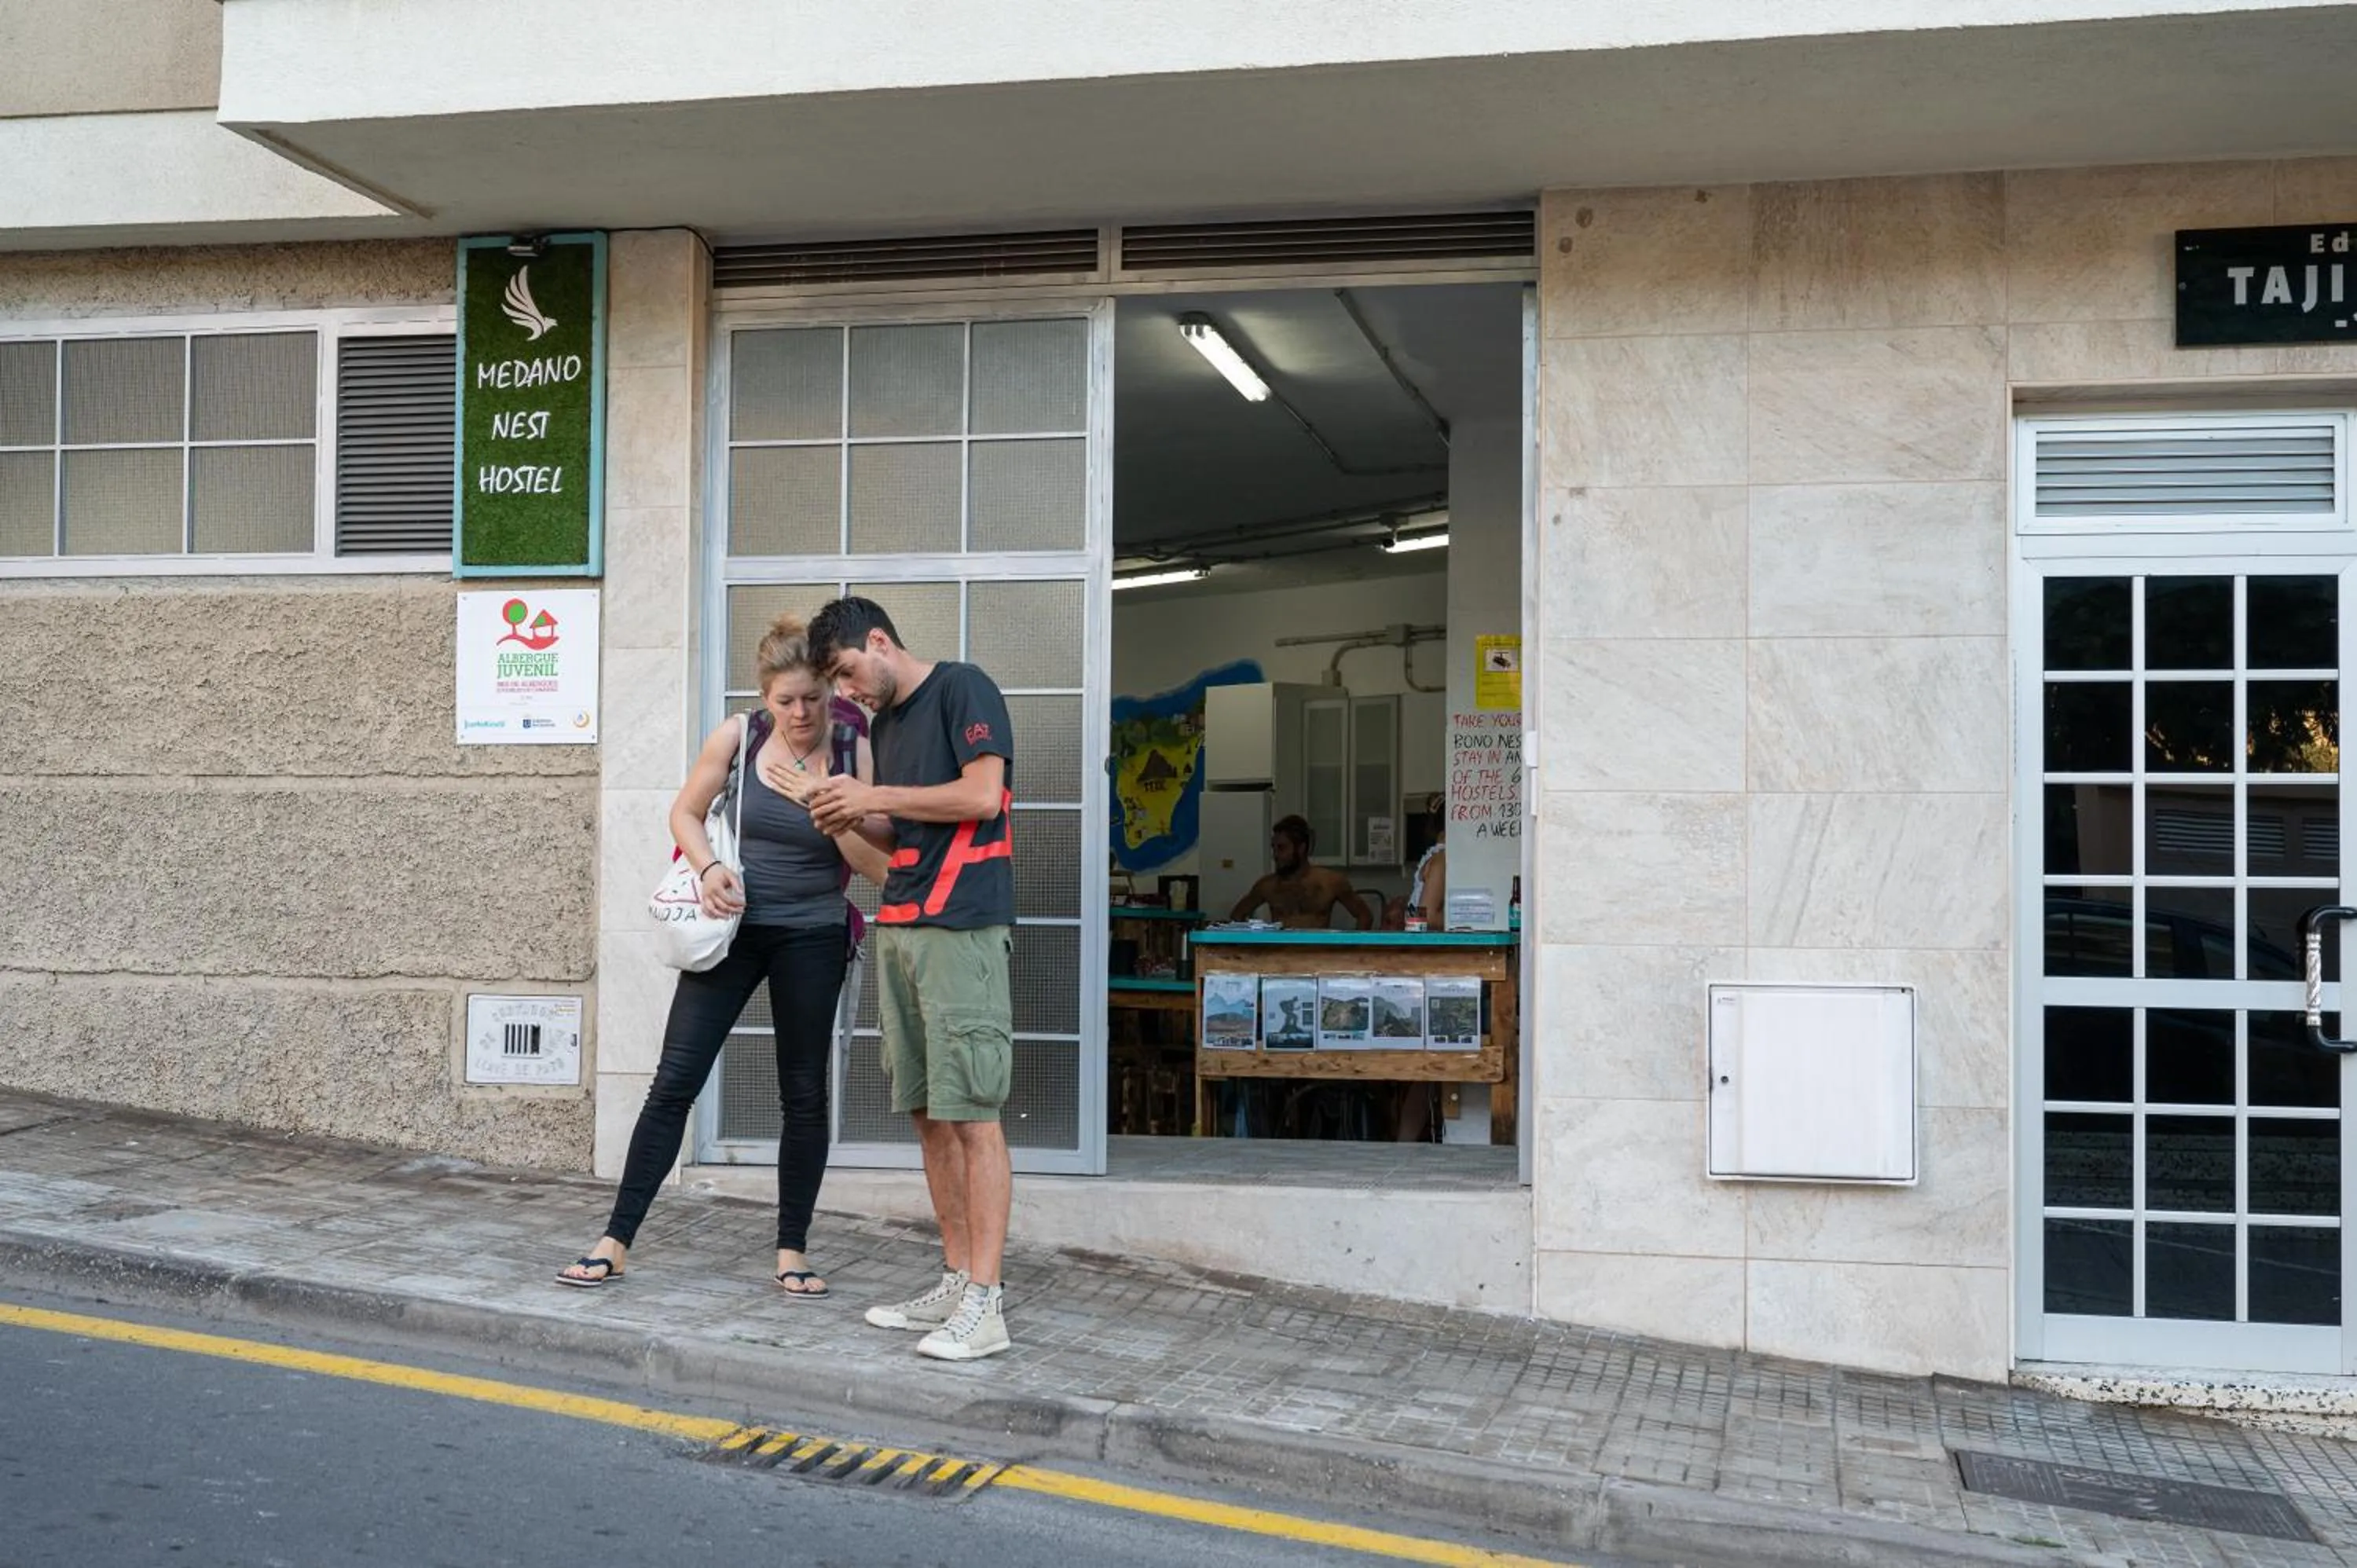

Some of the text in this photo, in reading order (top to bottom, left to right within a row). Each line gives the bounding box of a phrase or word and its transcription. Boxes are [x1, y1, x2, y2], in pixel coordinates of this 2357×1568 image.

[2227, 263, 2344, 313] TAJI
[478, 355, 581, 389] MEDANO
[491, 411, 551, 441] NEST
[479, 465, 563, 494] HOSTEL
[497, 653, 559, 664] ALBERGUE
[497, 664, 559, 679] JUVENIL
[1453, 713, 1484, 727] TAKE
[1453, 734, 1493, 749] BONO
[1453, 750, 1483, 767] STAY
[1487, 749, 1501, 764] IN
[1452, 769, 1472, 785] OF
[1477, 768, 1504, 785] THE
[1451, 804, 1492, 822] FROM
[1475, 822, 1487, 838] A
